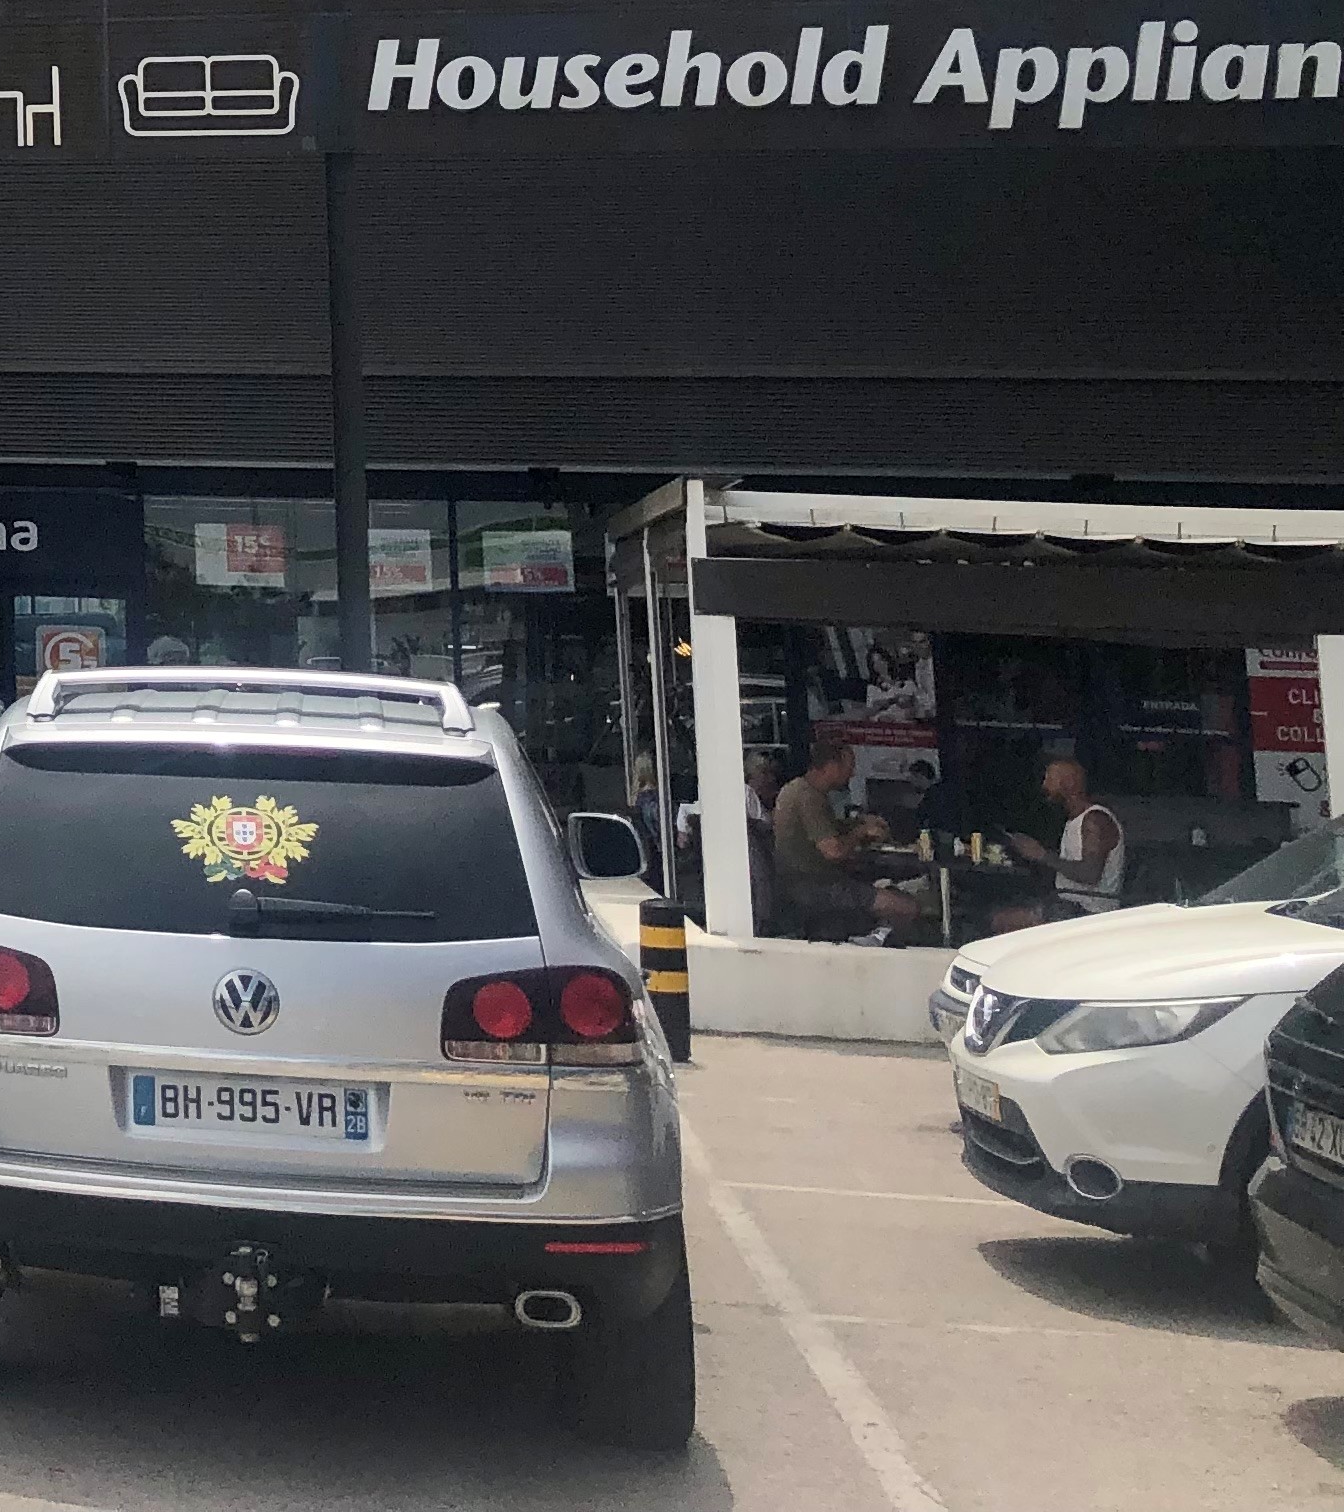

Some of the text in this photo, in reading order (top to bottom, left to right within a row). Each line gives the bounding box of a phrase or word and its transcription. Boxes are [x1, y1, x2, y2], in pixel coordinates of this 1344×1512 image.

[367, 20, 1342, 130] Household Applian
[1288, 688, 1320, 705] CLI
[1277, 726, 1325, 743] COLL
[160, 1083, 337, 1128] BH-995-VR
[346, 1115, 367, 1133] 2B
